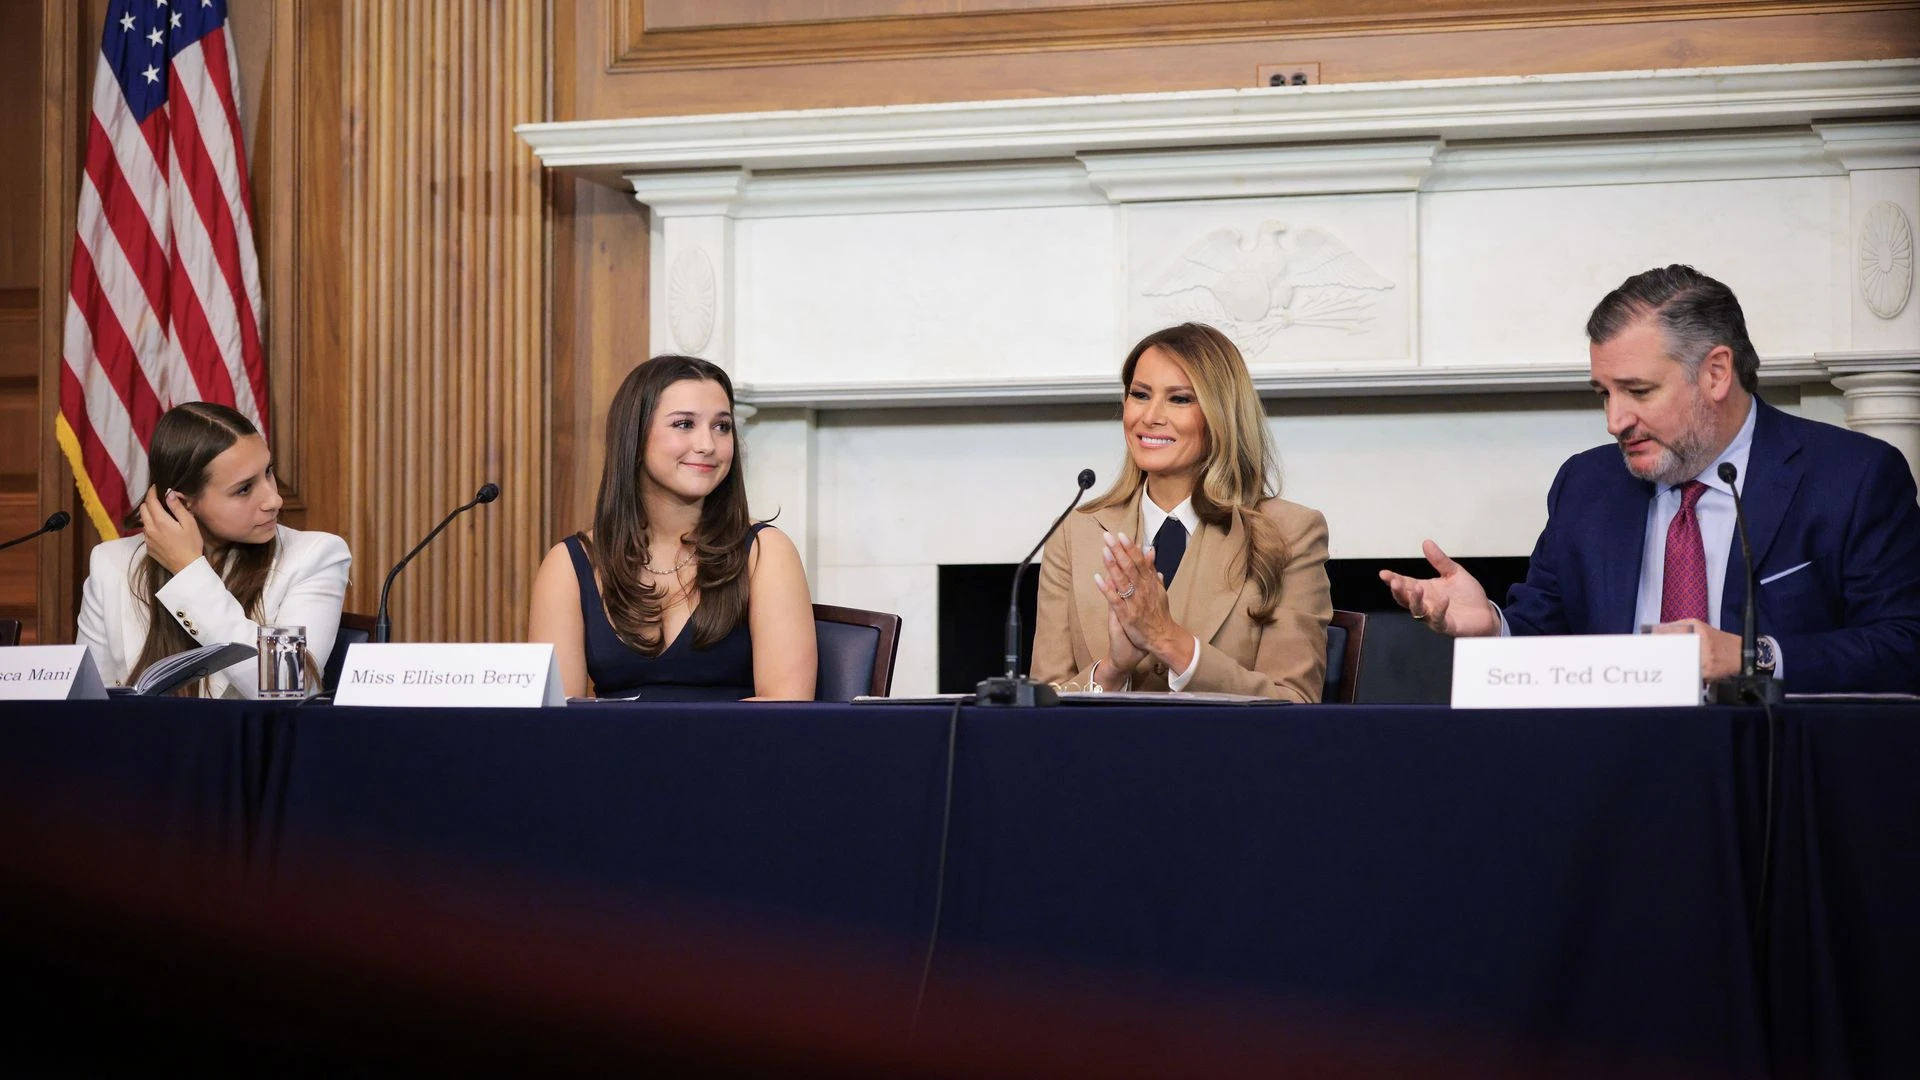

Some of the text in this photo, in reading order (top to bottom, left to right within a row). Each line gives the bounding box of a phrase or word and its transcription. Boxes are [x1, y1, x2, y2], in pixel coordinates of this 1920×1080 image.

[28, 667, 72, 681] Mani
[351, 669, 535, 688] Miss Elliston Berry
[1487, 666, 1664, 685] Sen. Ted Cruz
